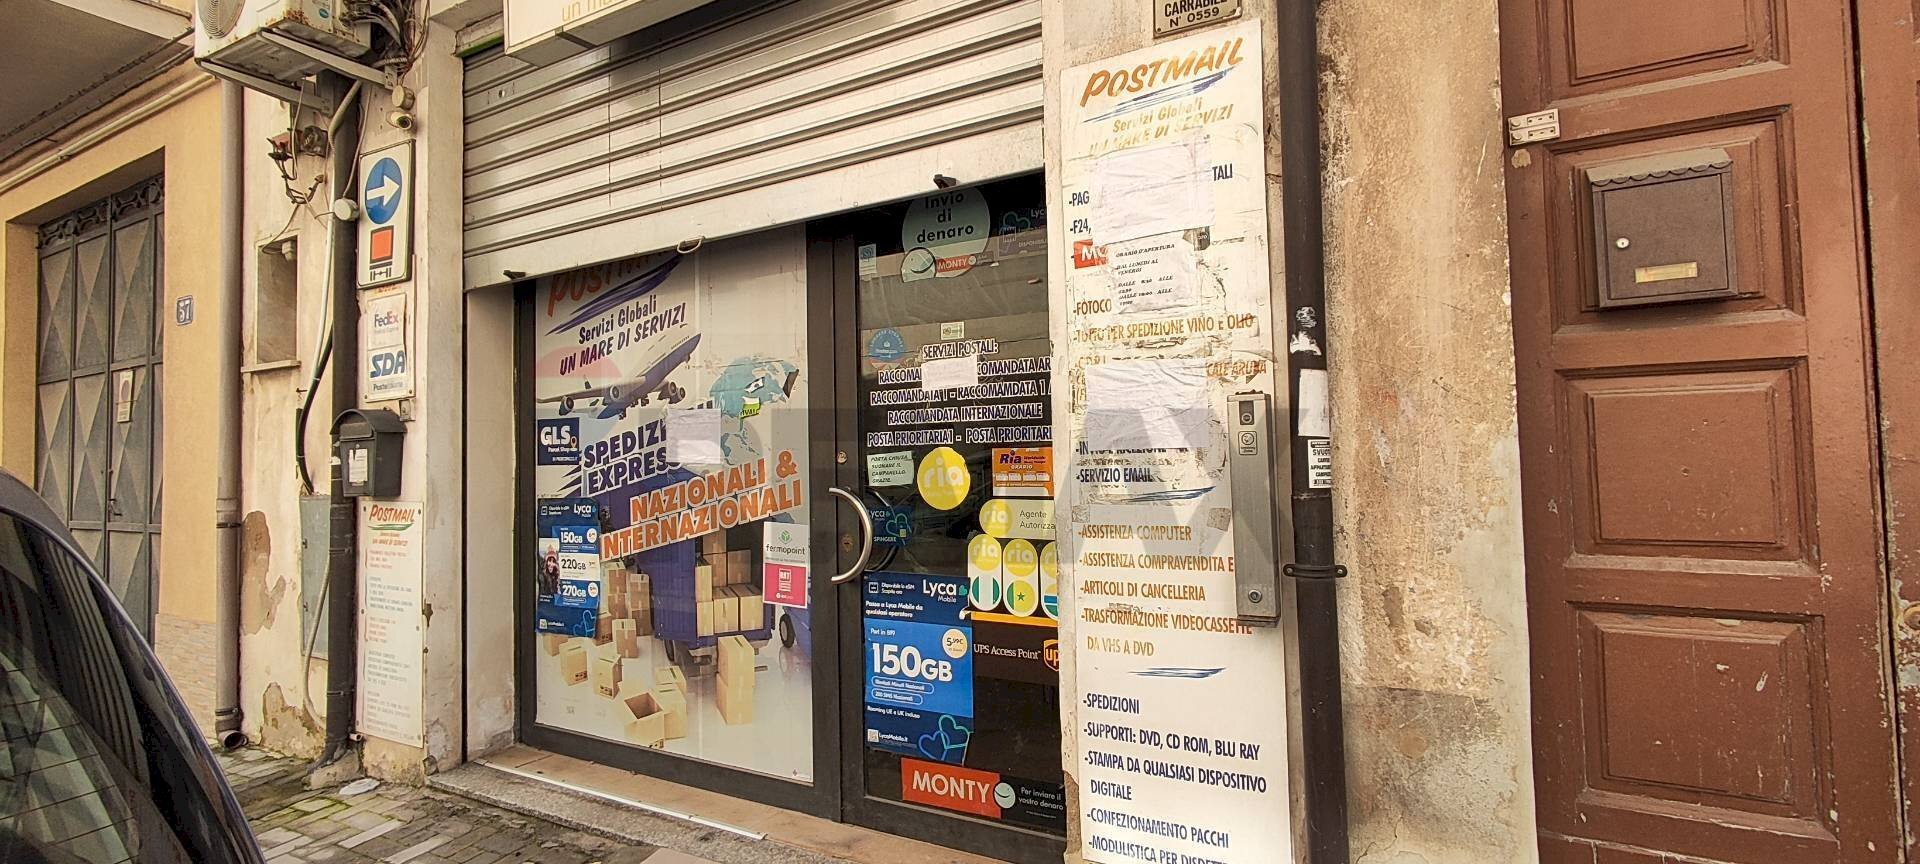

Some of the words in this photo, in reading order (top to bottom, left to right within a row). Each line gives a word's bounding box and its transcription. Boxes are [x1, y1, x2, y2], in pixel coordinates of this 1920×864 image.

[1187, 7, 1219, 23] 0559
[1080, 37, 1244, 107] POSTMAIL
[925, 191, 965, 209] Invio
[937, 208, 953, 224] di
[916, 224, 975, 244] denaro
[937, 258, 968, 270] MONTY
[179, 299, 191, 322] 57
[374, 310, 399, 328] FedEx
[578, 314, 615, 345] Servizi
[617, 295, 657, 328] Globali
[1127, 319, 1184, 338] SPEDIZIONE
[1187, 316, 1214, 333] VINO
[1227, 313, 1254, 330] OLIO
[559, 354, 576, 376] UN
[579, 340, 613, 368] MARE
[617, 331, 630, 348] DI
[633, 302, 687, 343] SERVIZI
[922, 342, 956, 360] SERVIZI
[958, 338, 999, 356] POSTALI:
[370, 350, 406, 379] SDA
[878, 367, 922, 385] RACCOMA
[888, 407, 961, 426] RACCOMANDATA
[962, 403, 1043, 422] INTERNAZIONALE
[867, 431, 895, 447] POSTA
[895, 430, 949, 446] PRIORITARIA
[965, 428, 997, 445] POSTA
[1000, 450, 1022, 464] Ria
[588, 446, 681, 495] EXPRES
[923, 456, 965, 489] ria
[1076, 467, 1121, 483] -SERVIZIO
[1123, 467, 1153, 483] EMAIL
[631, 457, 766, 523] NAZIONALI
[775, 450, 798, 479] &
[369, 504, 416, 522] POSTMAIL
[573, 503, 592, 514] Lyca
[983, 504, 1009, 523] ria
[1019, 509, 1047, 520] Agente
[560, 531, 583, 544] 150GB
[1078, 524, 1134, 541] -ASSISTENZA
[1136, 525, 1192, 542] COMPUTER
[765, 543, 806, 555] fermopoint
[972, 538, 999, 557] ria
[1007, 543, 1034, 563] ria
[560, 558, 587, 571] 220GB
[1079, 552, 1136, 569] -ASSISTENZA
[1138, 554, 1225, 573] COMPRAVENDITA
[1228, 556, 1235, 572] E
[562, 585, 586, 598] 270GB
[923, 579, 957, 597] Lyca
[1080, 580, 1125, 597] -ARTICOLI
[1127, 582, 1138, 597] DI
[1141, 583, 1206, 601] CANCELLERIA
[898, 602, 915, 610] Mobile
[1081, 607, 1169, 629] -TRASFORMAZIONE
[973, 643, 990, 654] UPS
[990, 646, 1017, 657] Access
[1087, 636, 1099, 651] DA
[1102, 637, 1121, 654] VHS
[1123, 639, 1131, 655] A
[1133, 640, 1155, 657] DVD
[872, 642, 953, 682] 150GB
[1083, 693, 1140, 715] -SPEDIZIONI
[1083, 721, 1137, 743] -SUPPORTI:
[1139, 729, 1164, 750] DVD,
[1166, 733, 1181, 750] CD
[1183, 735, 1212, 757] ROM,
[1215, 740, 1236, 759] BLU
[1239, 743, 1261, 761] RAY
[1084, 750, 1124, 771] -STAMPA
[1126, 756, 1141, 774] DA
[1143, 759, 1195, 782] QUALSIASI
[1199, 768, 1267, 794] DISPOSITIVO
[912, 770, 991, 804] MONTY
[1020, 786, 1031, 795] Per
[1032, 789, 1055, 800] inviare
[1056, 793, 1062, 801] il
[1090, 779, 1132, 801] DIGITALE
[1018, 796, 1039, 806] vostro
[1039, 800, 1064, 811] denaro
[1086, 807, 1188, 841] -CONFEZIONAMENTO
[1190, 826, 1230, 849] PACCHI
[1088, 835, 1157, 863] -MODULISTICA
[1159, 848, 1178, 864] PER
